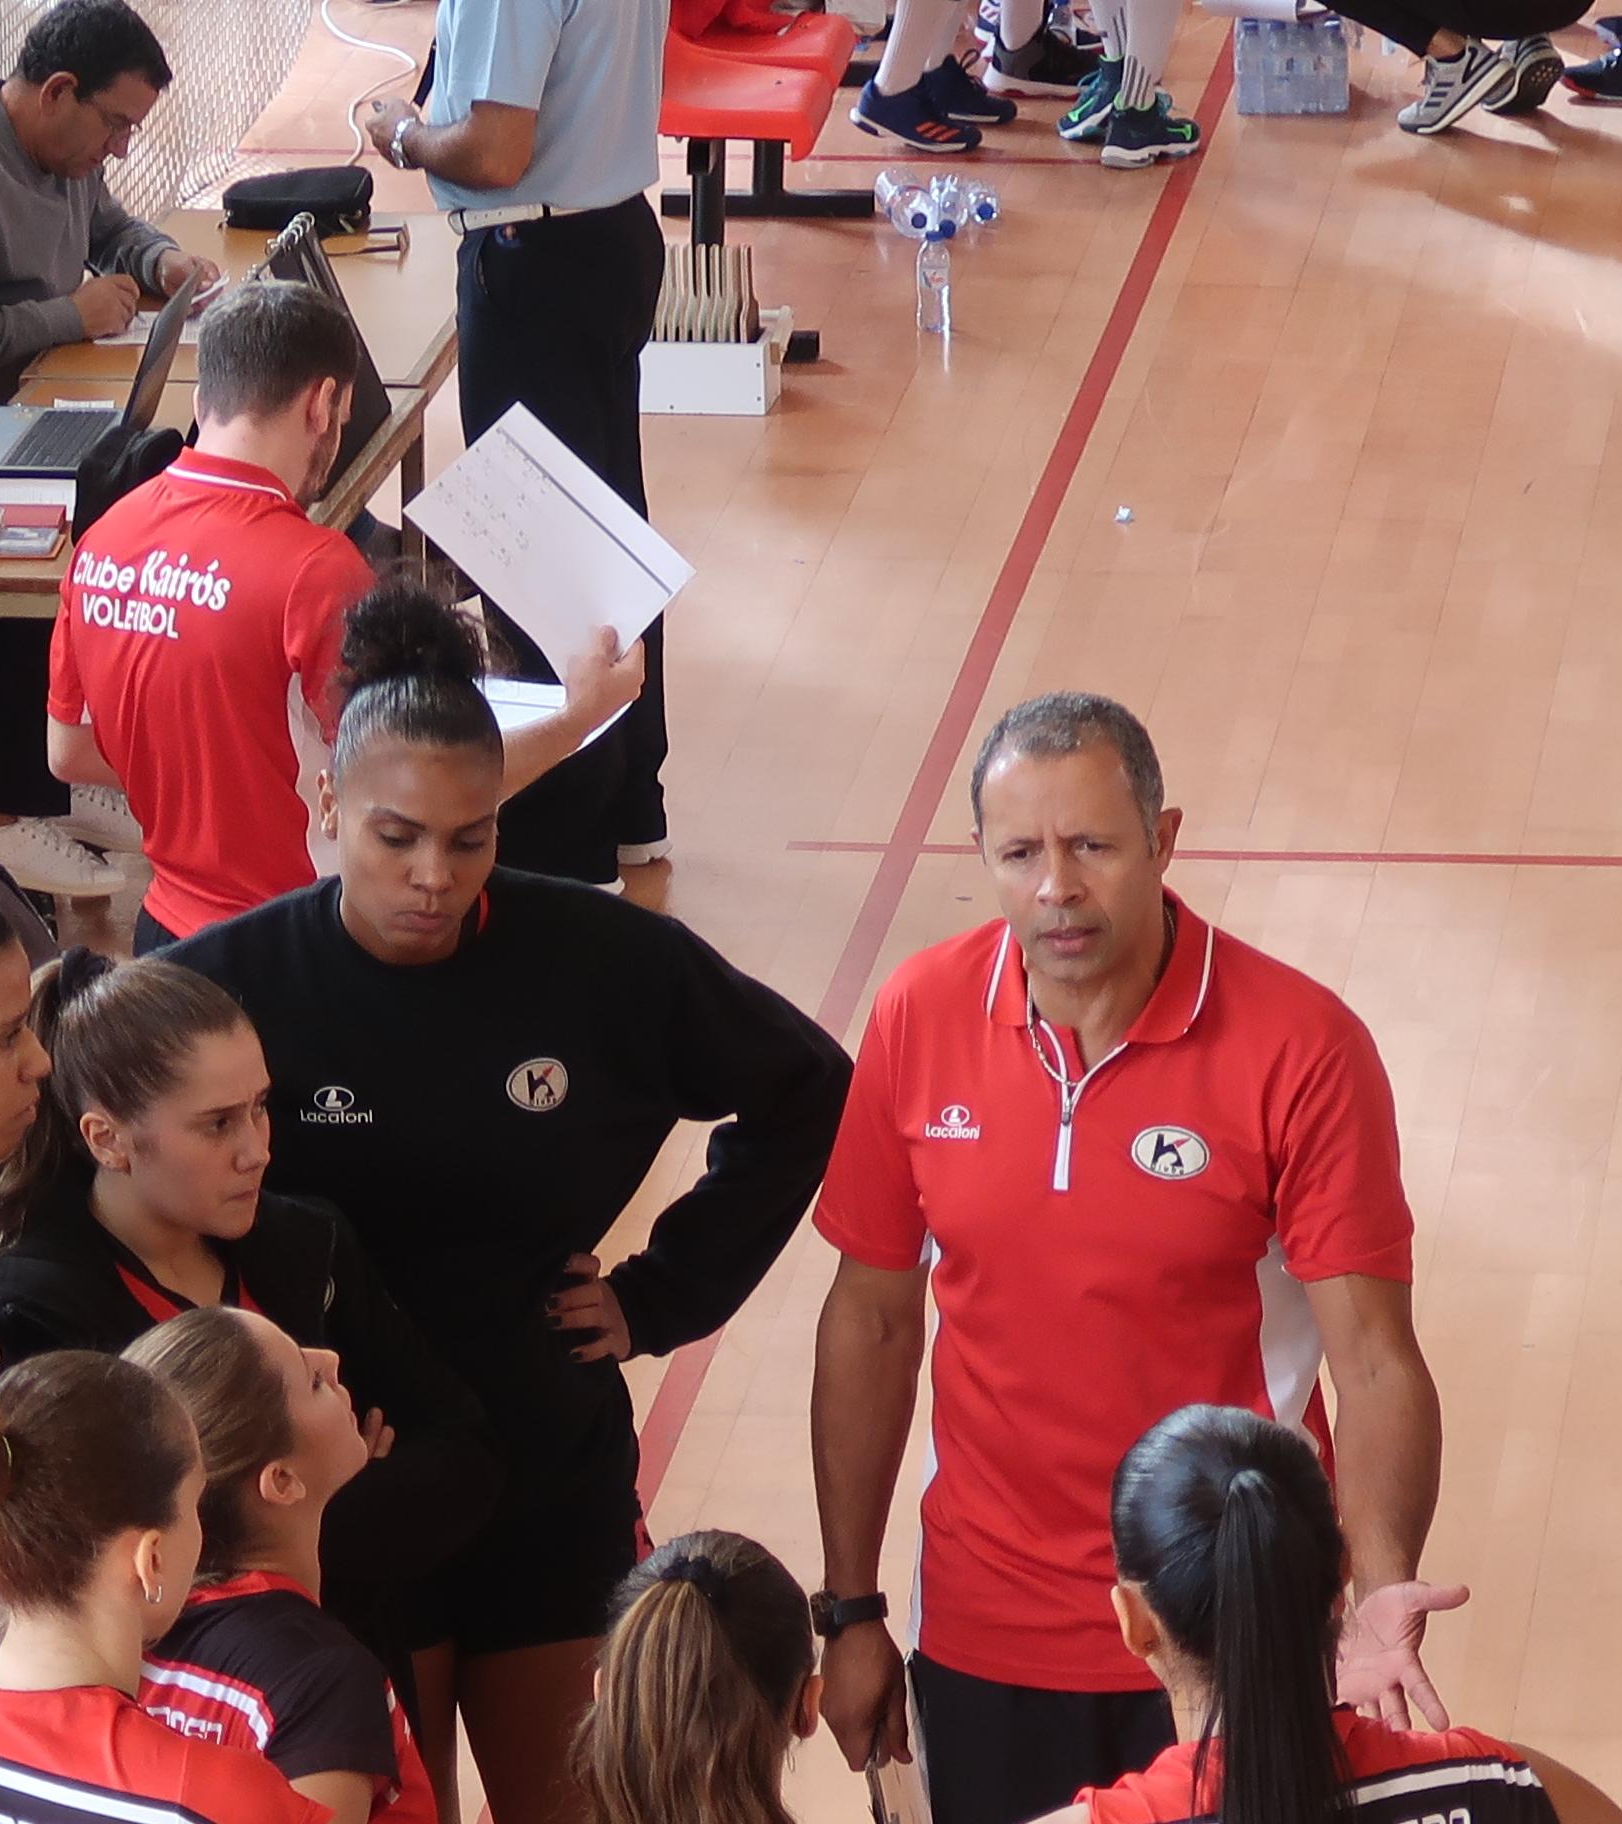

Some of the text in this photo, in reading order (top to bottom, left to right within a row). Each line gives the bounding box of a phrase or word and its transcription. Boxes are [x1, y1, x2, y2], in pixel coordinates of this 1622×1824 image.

[72, 550, 231, 611] Clube Kairós
[82, 592, 179, 640] VOLEIBOL
